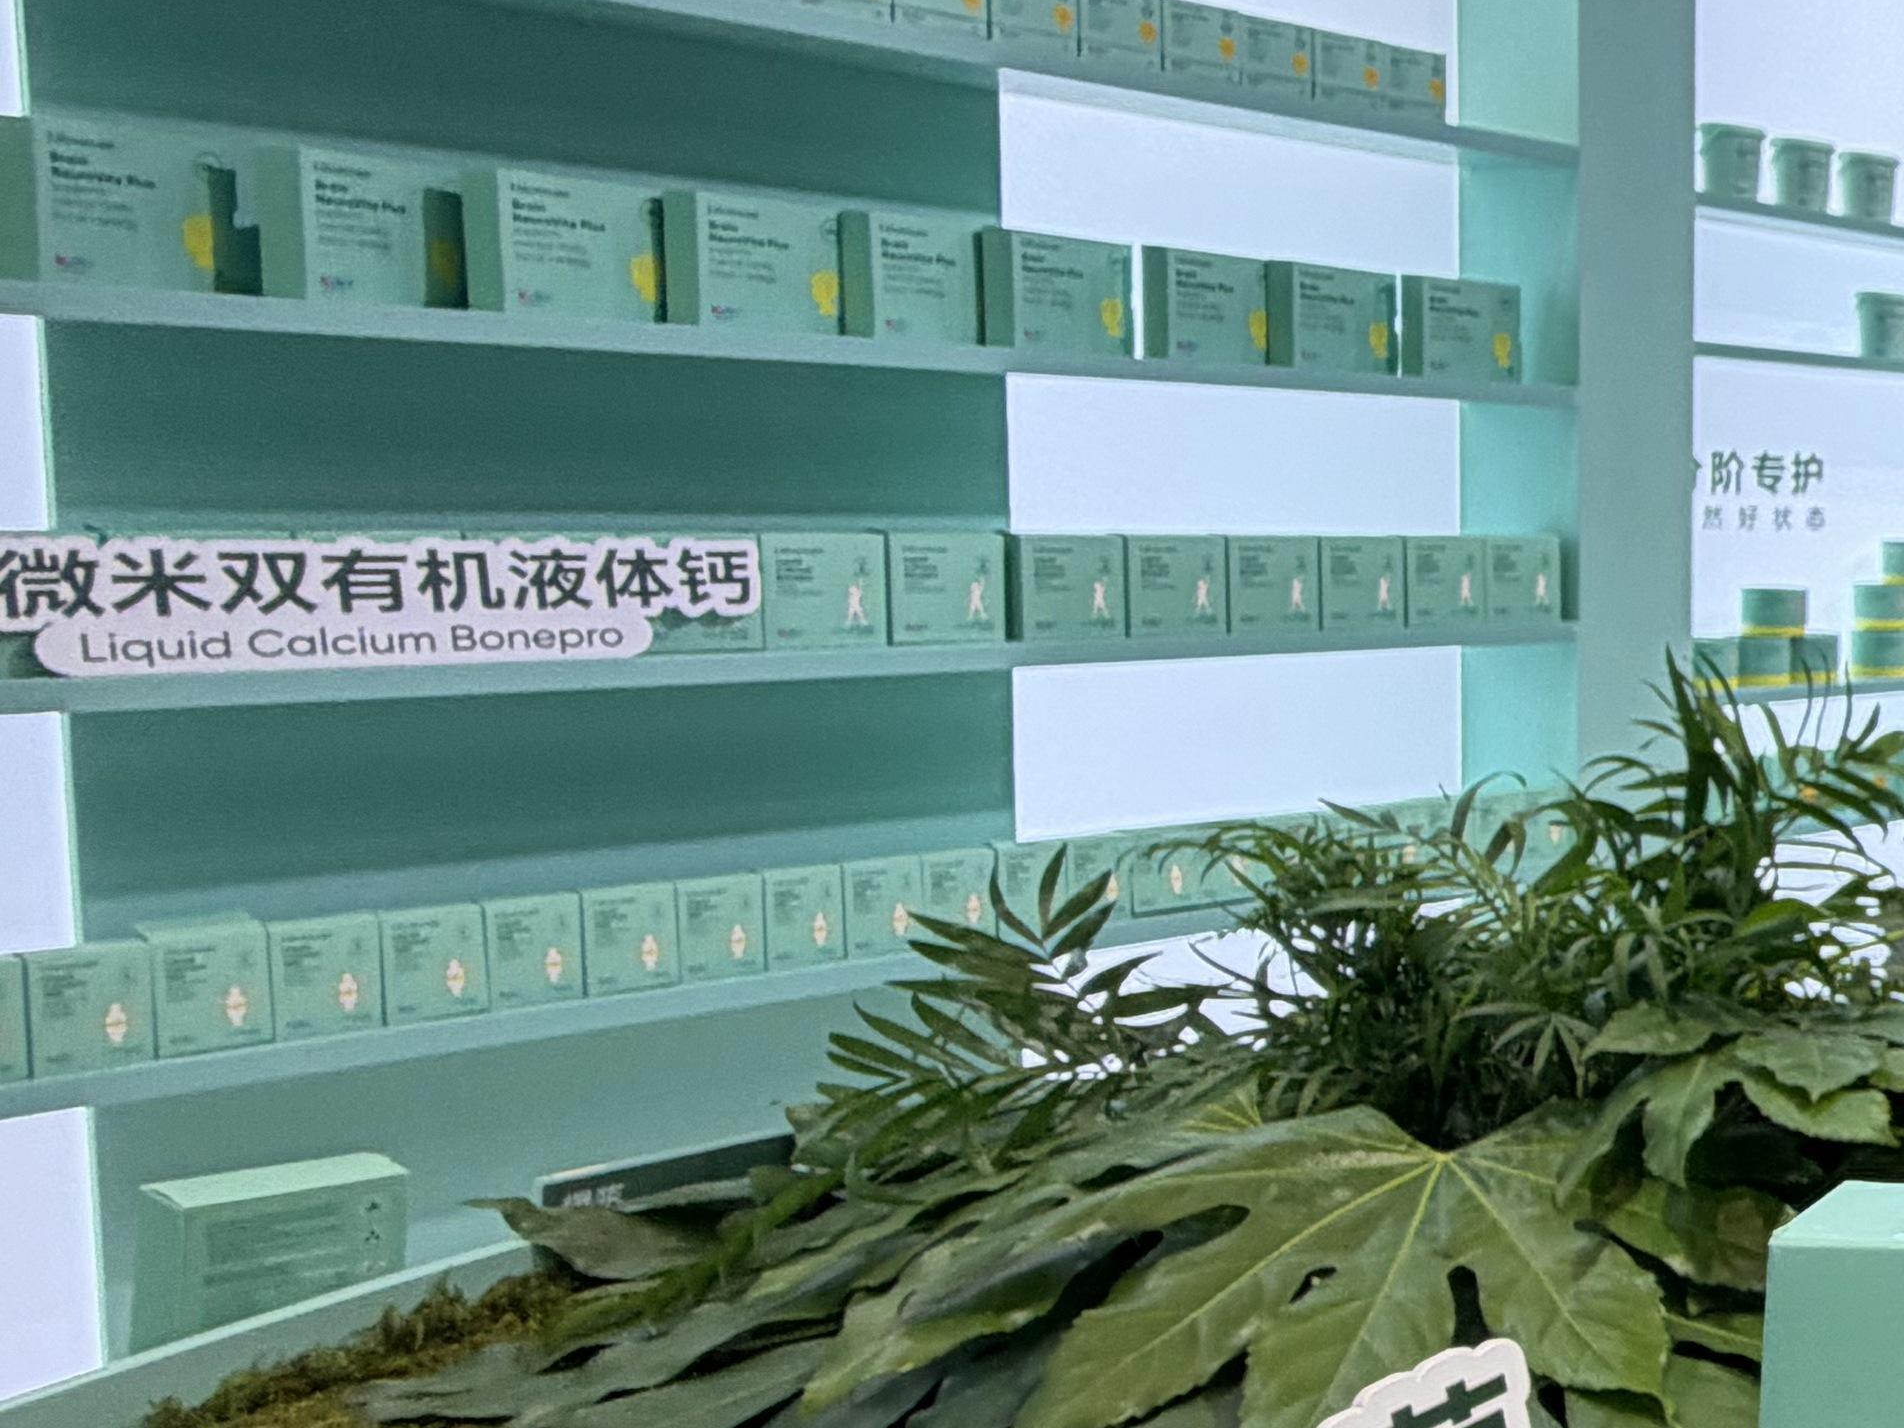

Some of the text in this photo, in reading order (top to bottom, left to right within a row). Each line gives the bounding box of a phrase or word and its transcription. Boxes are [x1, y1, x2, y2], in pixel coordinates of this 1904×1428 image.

[0, 547, 751, 618] 微米双有机液体钙
[80, 622, 625, 668] Liquid Calcium Bonepro
